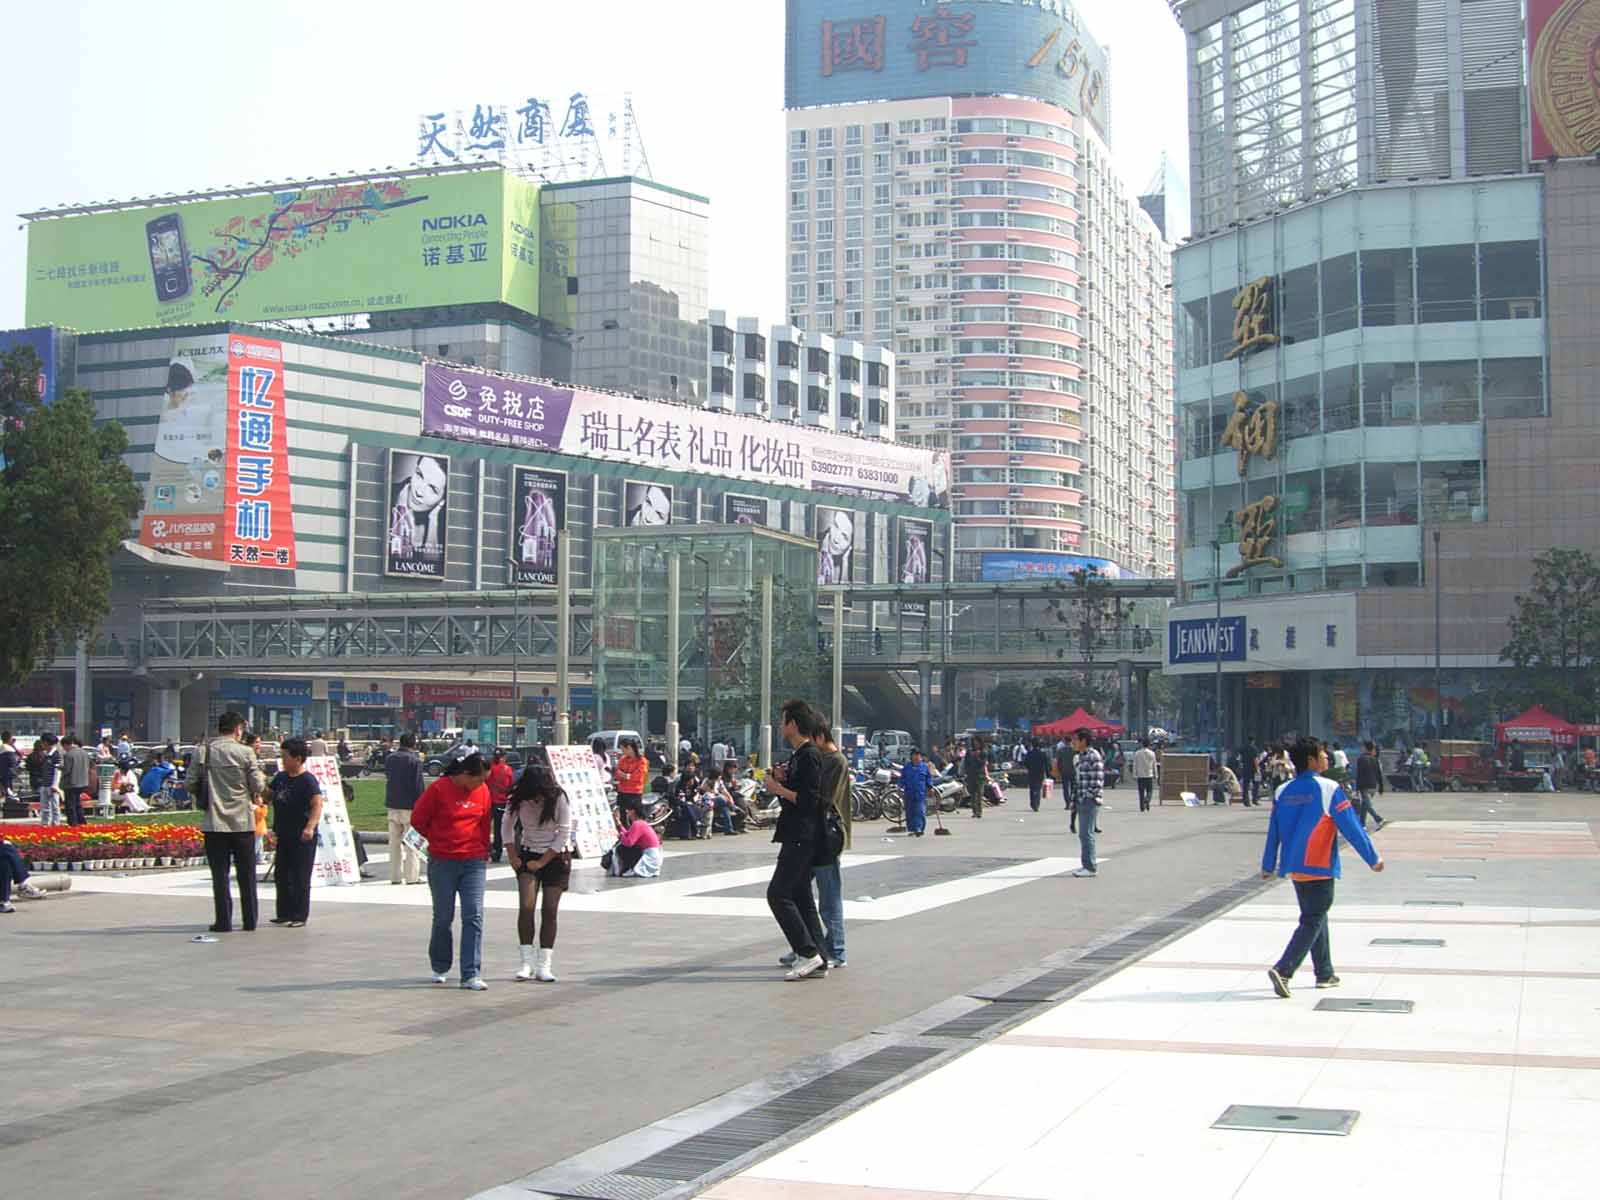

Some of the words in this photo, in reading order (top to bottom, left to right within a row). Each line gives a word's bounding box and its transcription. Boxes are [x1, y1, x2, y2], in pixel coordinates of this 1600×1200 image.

[421, 213, 488, 231] NOKIA
[422, 232, 462, 245] Connecting
[464, 229, 489, 241] People
[421, 241, 489, 267] 诺基亚
[443, 404, 472, 418] CSDF
[478, 386, 545, 420] 免税店
[478, 414, 523, 430] DUTY-FREE
[523, 421, 545, 432] SHOP
[579, 410, 681, 461] 瑞士名表
[687, 423, 732, 470] 礼品
[740, 433, 804, 480] 化妆品
[231, 545, 289, 564] 天然一楼
